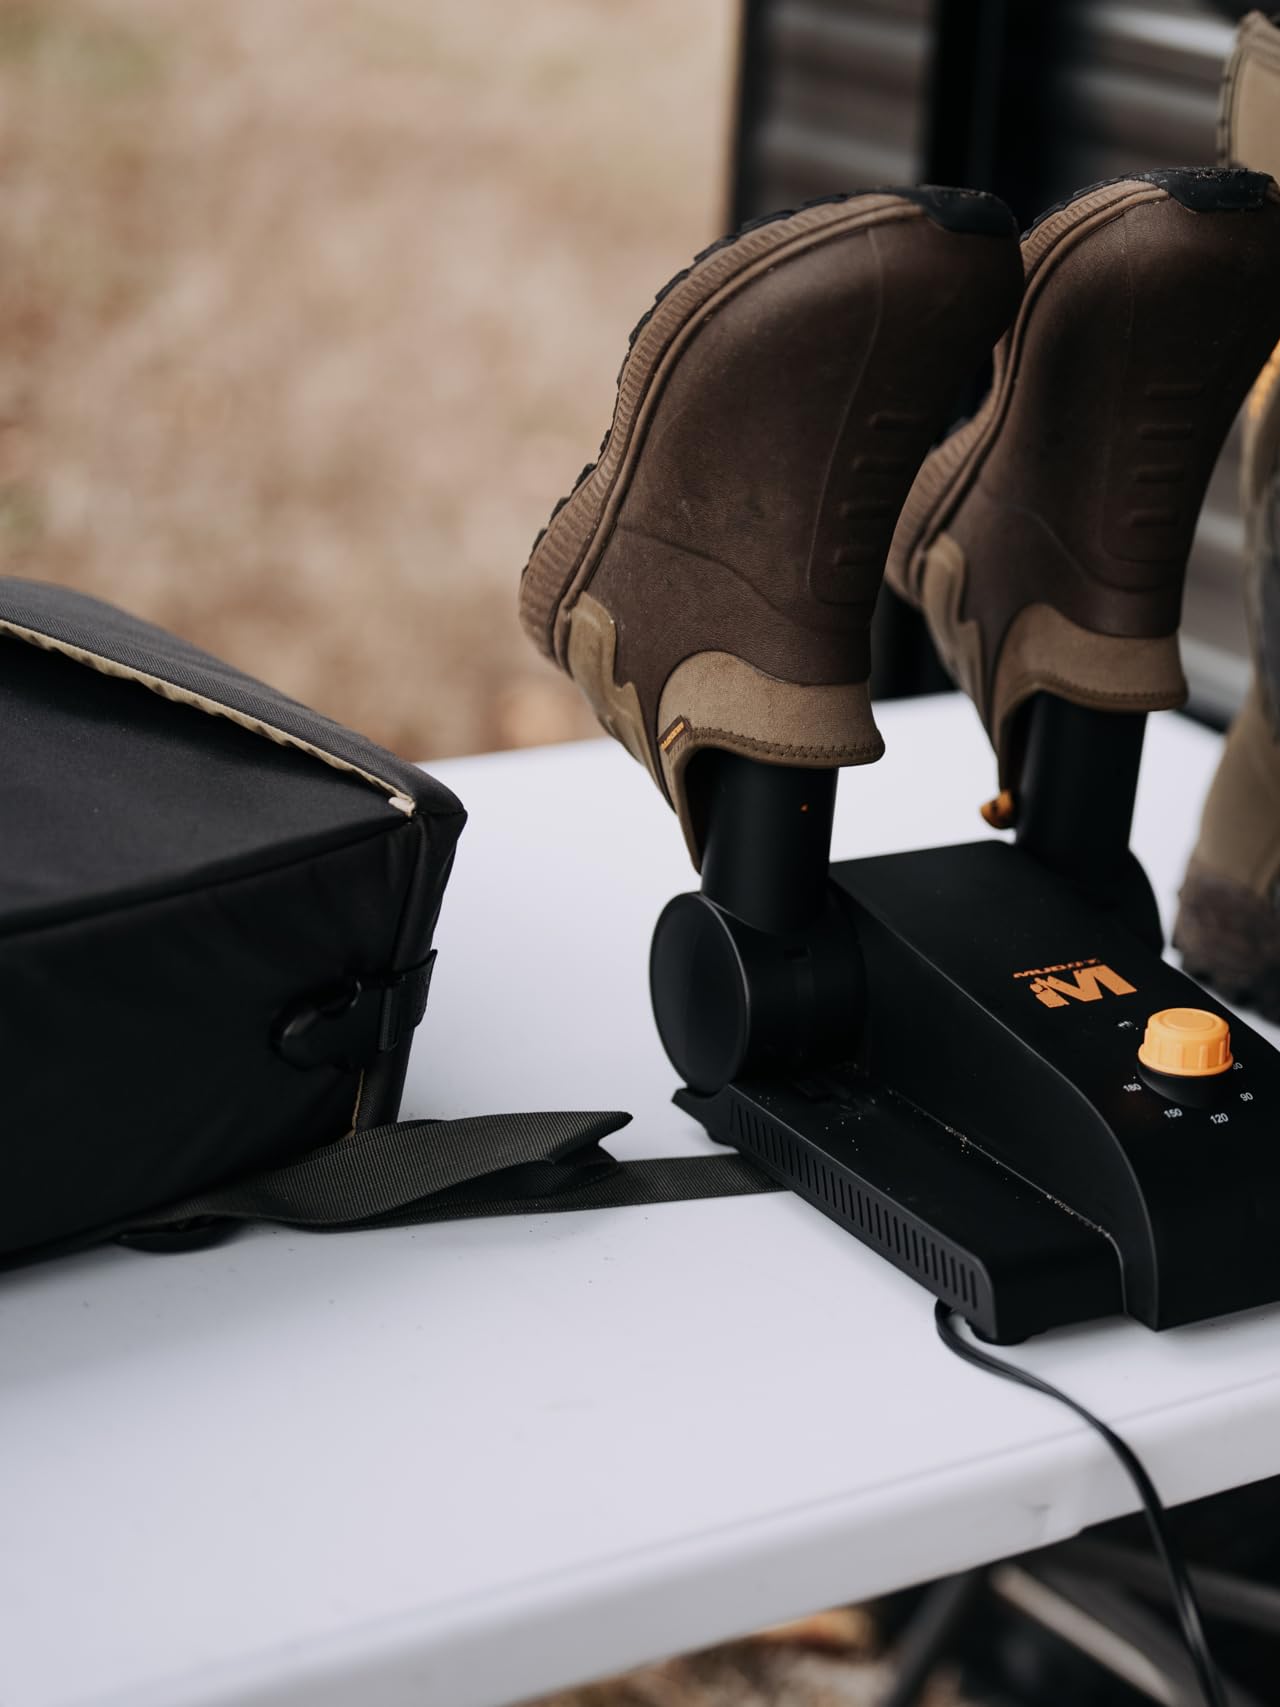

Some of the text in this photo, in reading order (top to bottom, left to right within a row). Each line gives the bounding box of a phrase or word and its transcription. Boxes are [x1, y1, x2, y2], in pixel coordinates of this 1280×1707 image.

[1240, 1092, 1254, 1102] 90
[1164, 1108, 1183, 1119] 150
[1210, 1113, 1229, 1124] 120
